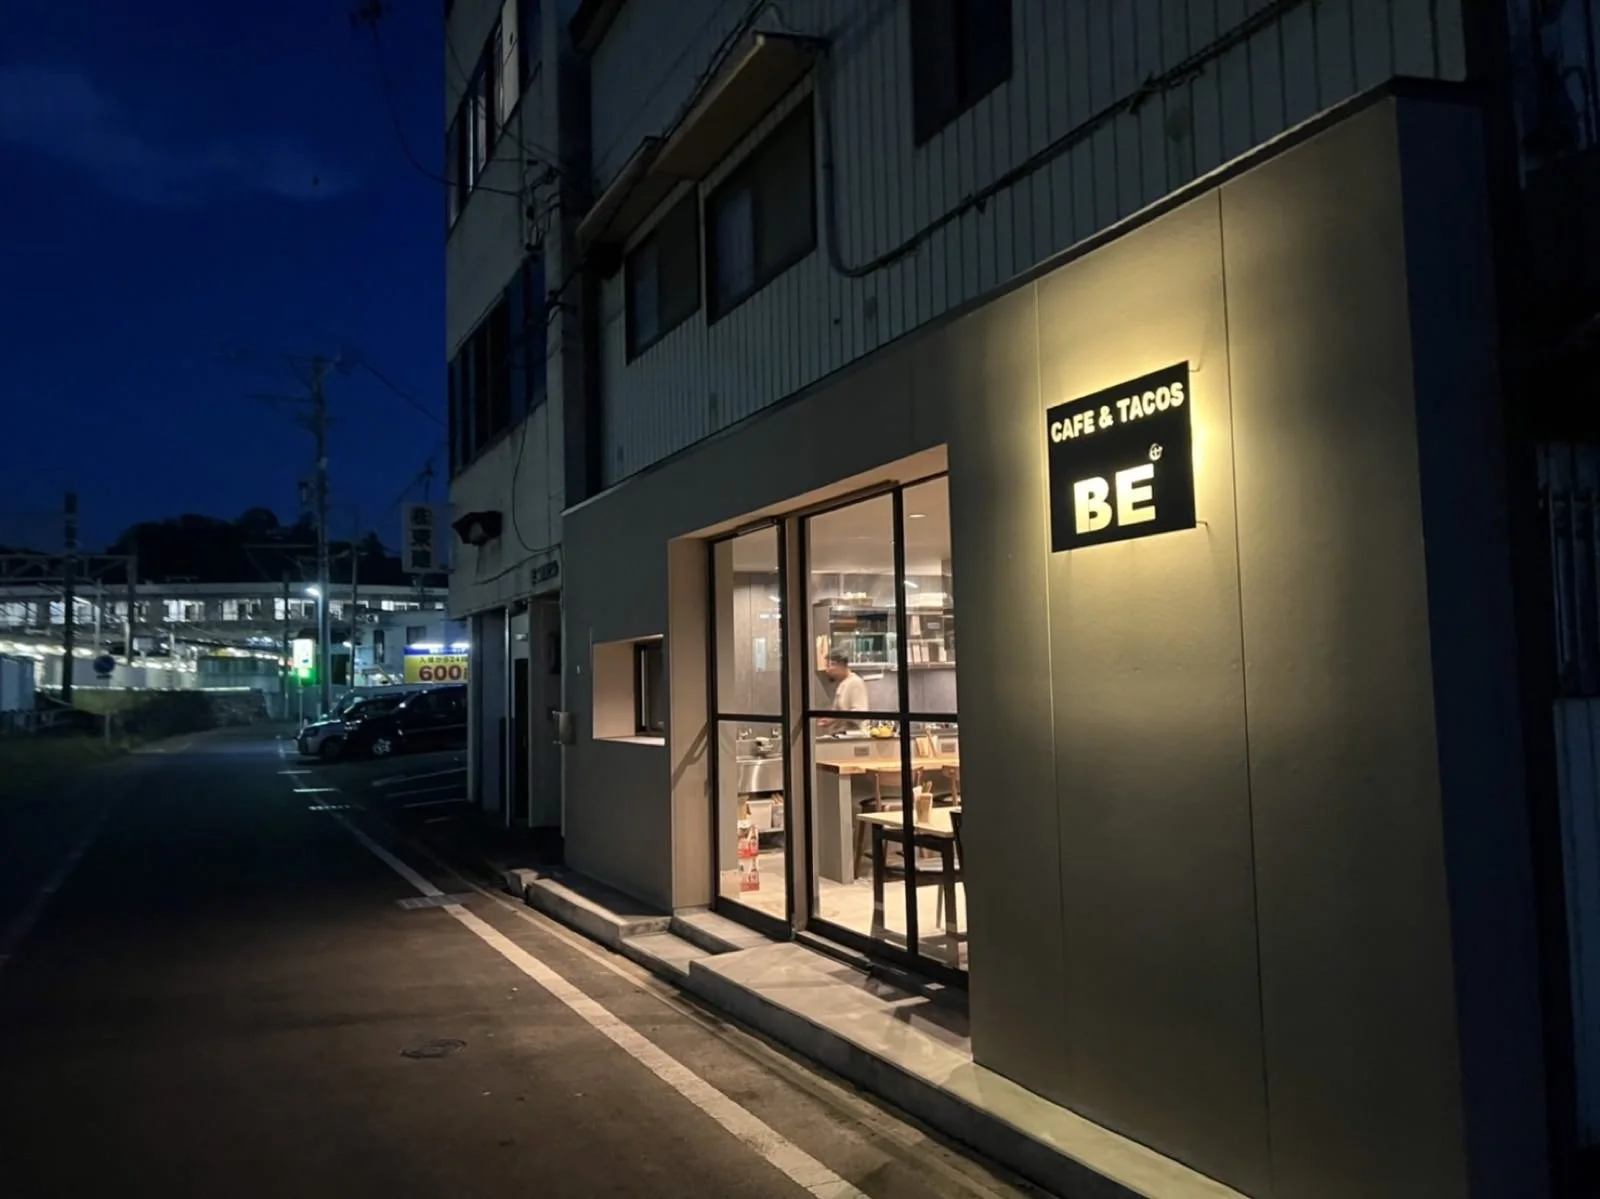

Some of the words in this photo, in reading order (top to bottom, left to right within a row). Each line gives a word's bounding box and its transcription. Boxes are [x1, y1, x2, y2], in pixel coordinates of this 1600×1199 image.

[1051, 410, 1095, 443] CAFE
[1099, 405, 1114, 429] &
[1116, 382, 1185, 423] TACOS
[1073, 463, 1157, 535] BE
[419, 665, 462, 682] 600
